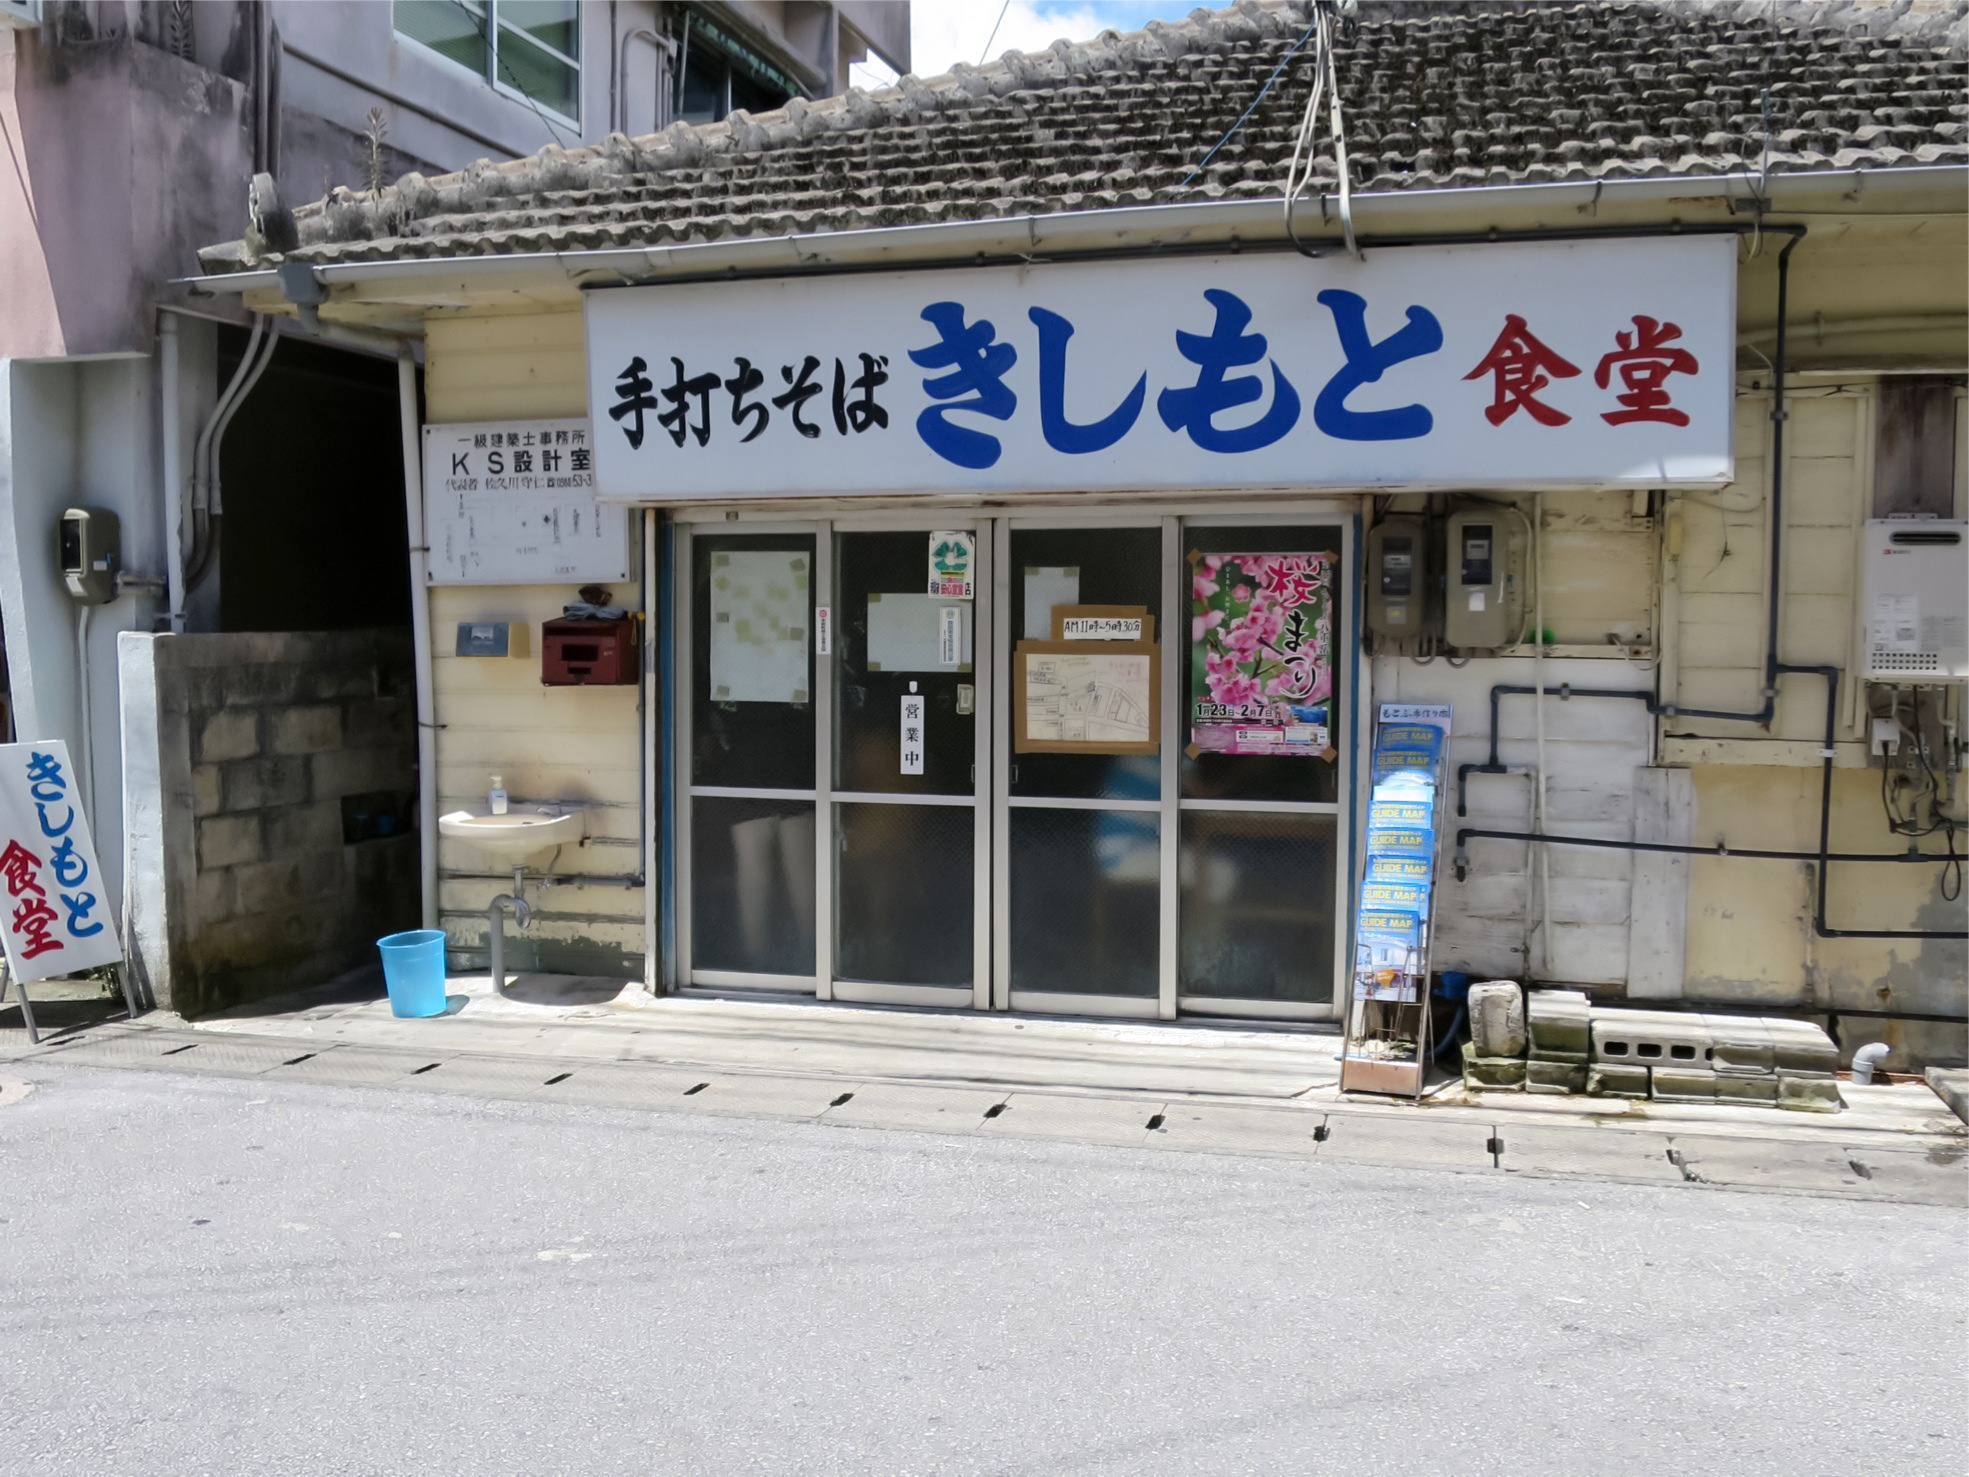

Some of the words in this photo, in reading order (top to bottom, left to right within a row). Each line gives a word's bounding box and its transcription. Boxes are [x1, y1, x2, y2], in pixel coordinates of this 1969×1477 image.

[608, 352, 889, 450] 手打ちそば
[906, 288, 1444, 469] きしもと
[1460, 313, 1700, 427] 食堂
[457, 430, 586, 449] 一級建築士事務所
[904, 703, 920, 767] 営業中
[1376, 756, 1405, 765] GUIDE
[1407, 756, 1430, 765] MAP
[1371, 809, 1400, 818] GUIDE
[1402, 810, 1425, 819] MAP
[26, 751, 104, 938] きしもと
[1370, 835, 1398, 845] GUIDE
[1400, 835, 1423, 845] MAP
[1372, 863, 1402, 873] GUIDE
[1404, 864, 1428, 874] MAP
[0, 838, 65, 960] 食堂
[1363, 890, 1391, 899] GUIDE
[1393, 891, 1417, 900] MAP
[1360, 918, 1387, 927] GUIDE
[1389, 919, 1413, 928] MAP
